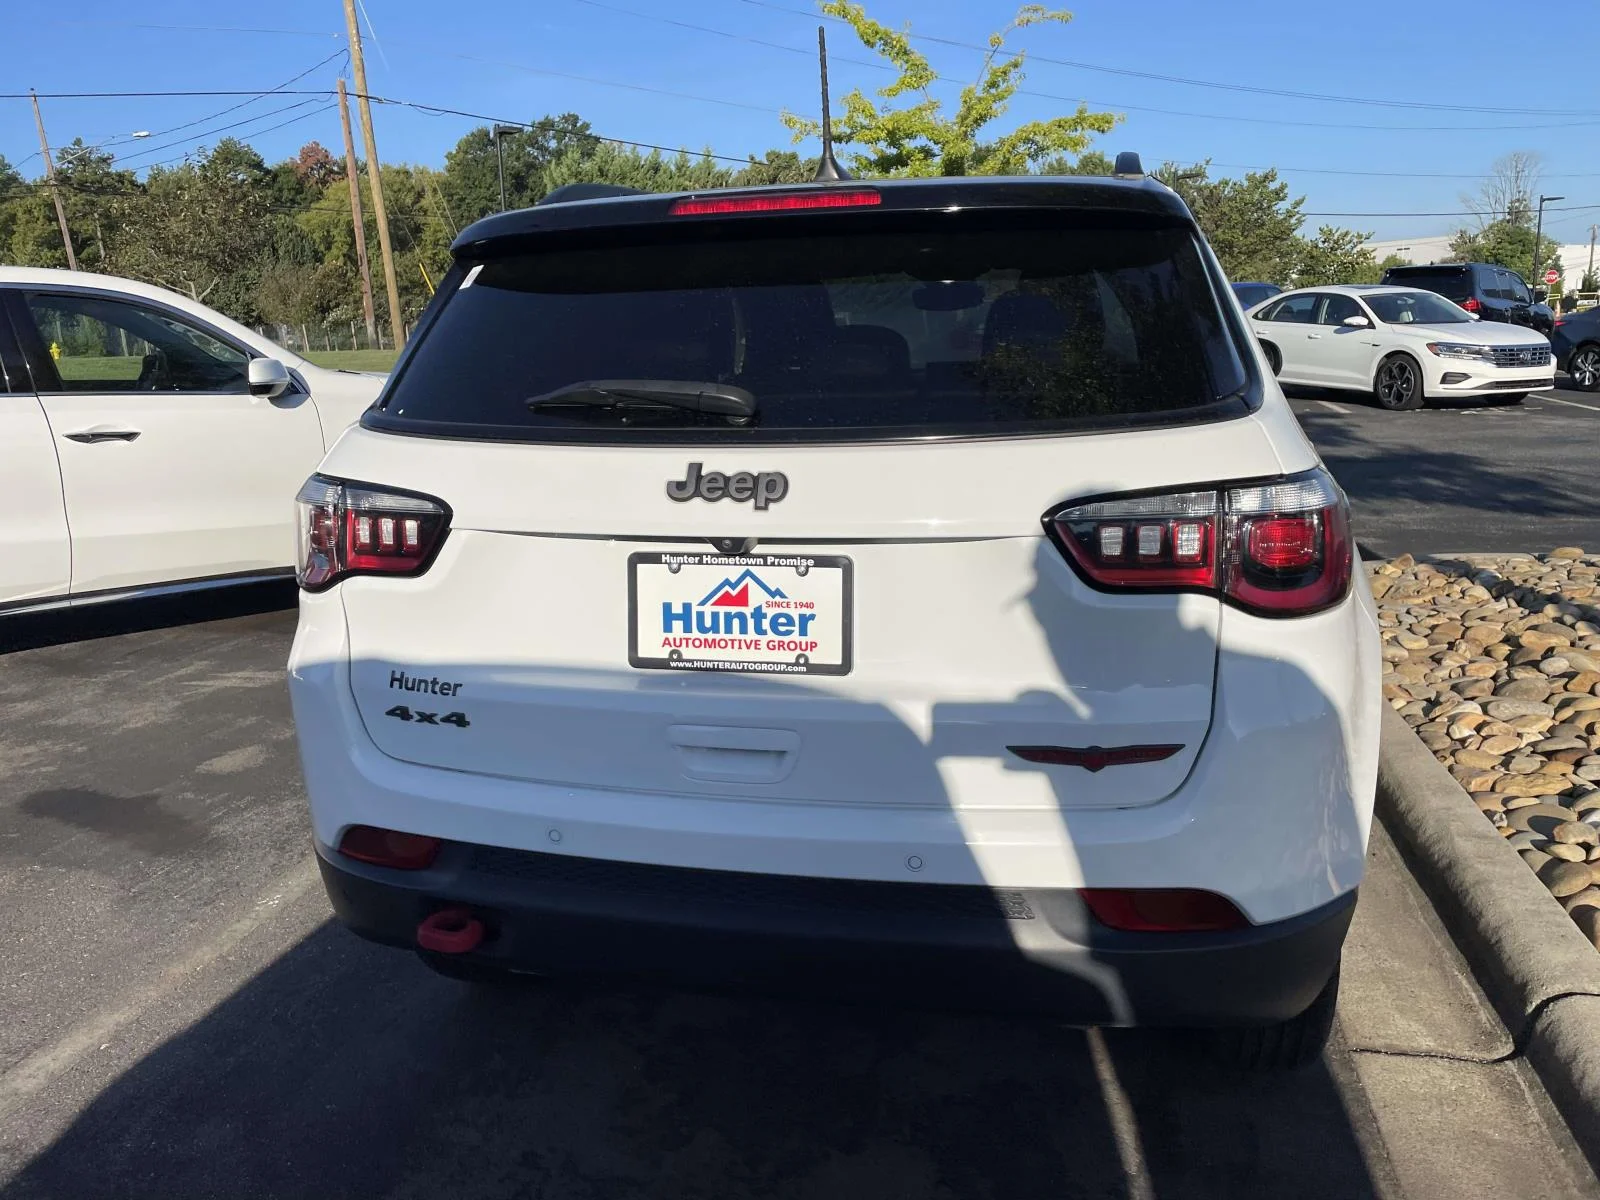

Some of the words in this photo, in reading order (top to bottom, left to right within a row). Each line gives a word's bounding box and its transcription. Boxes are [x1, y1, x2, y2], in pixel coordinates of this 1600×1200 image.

[666, 462, 789, 511] Jeep
[661, 554, 700, 564] Hunter
[702, 555, 764, 565] Hometown
[766, 556, 815, 566] Promise
[765, 600, 791, 609] SINCE
[793, 601, 814, 610] 1940
[661, 601, 817, 637] Hunter
[661, 637, 761, 650] AUTOMOTIVE
[766, 639, 818, 652] GROUP
[669, 660, 807, 673] www.HUNTERAUTOGROUP.com
[389, 670, 464, 697] Hunter
[384, 704, 471, 728] 4x4
